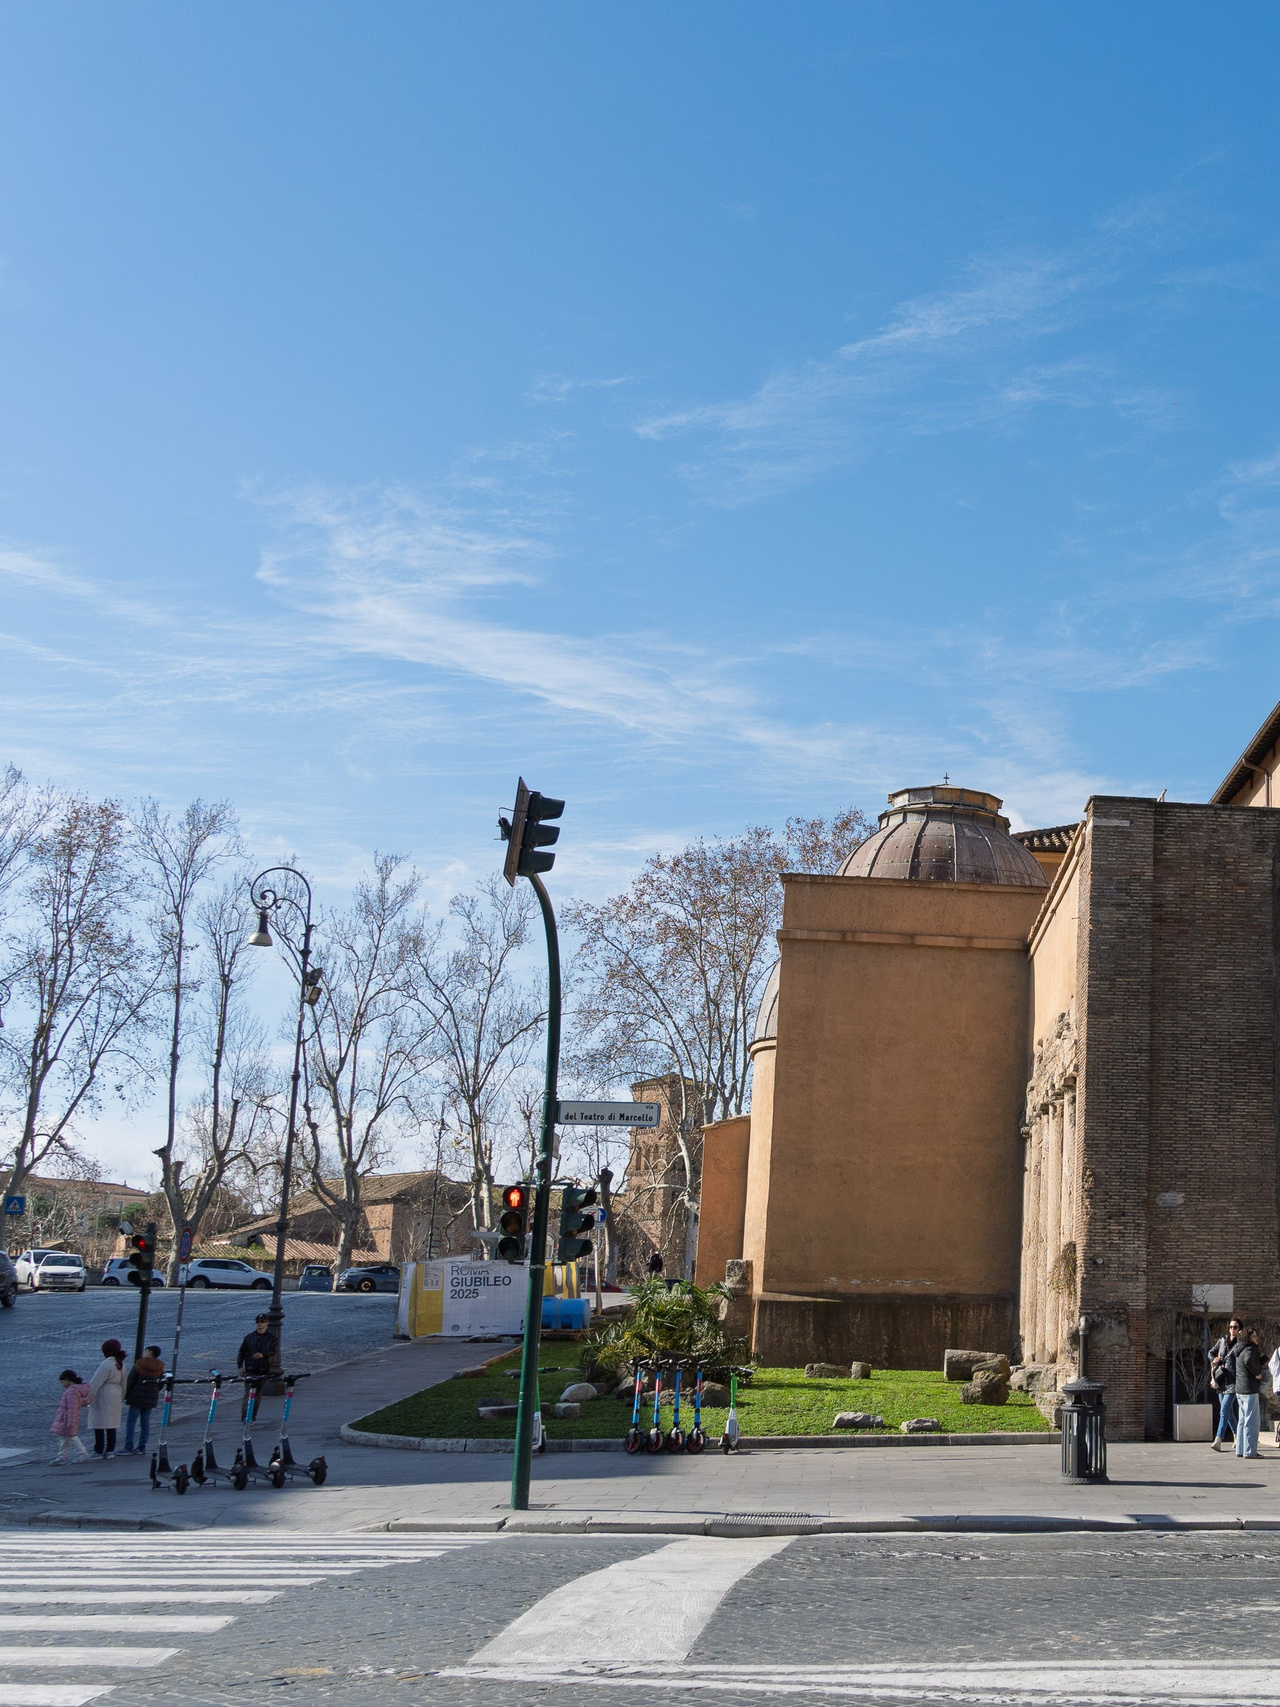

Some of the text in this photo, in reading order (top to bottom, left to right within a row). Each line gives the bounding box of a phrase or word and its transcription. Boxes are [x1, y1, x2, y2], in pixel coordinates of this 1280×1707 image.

[564, 1112, 654, 1122] del Teatro di Marcello
[450, 1276, 511, 1287] GIUBILEO
[450, 1289, 480, 1300] 2025
